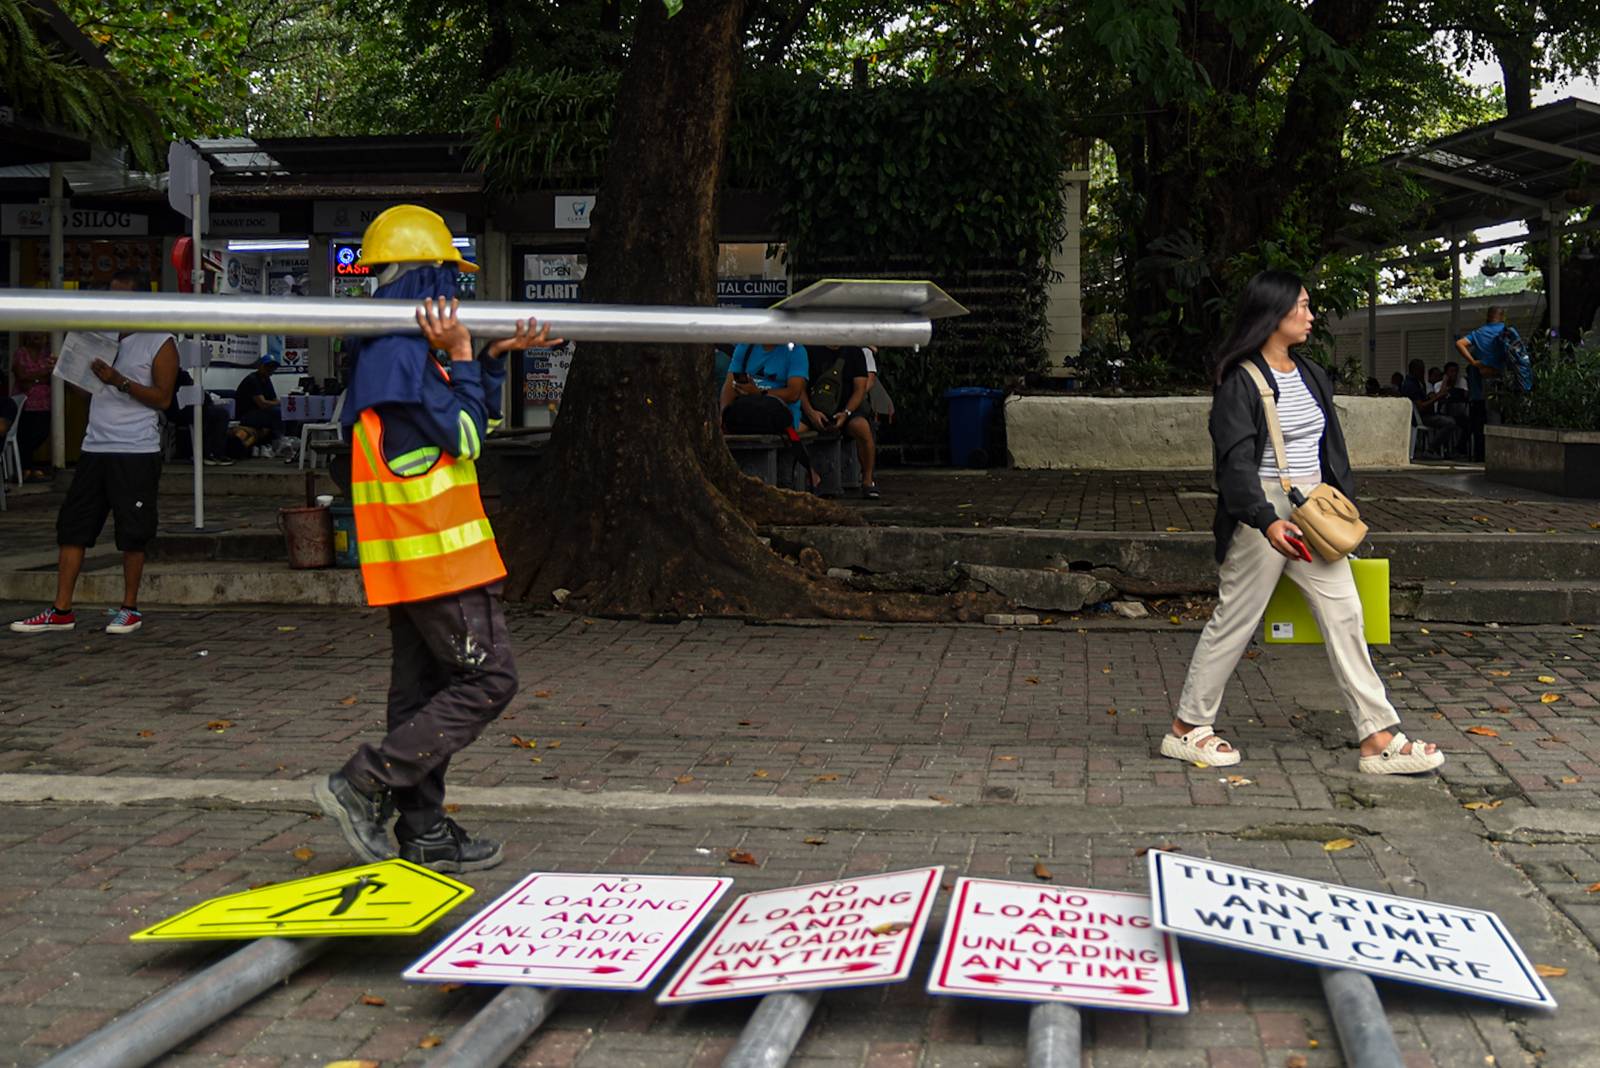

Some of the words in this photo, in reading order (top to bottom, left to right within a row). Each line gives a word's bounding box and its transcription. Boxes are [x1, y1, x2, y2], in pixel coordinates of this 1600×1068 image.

[72, 212, 131, 227] SILOG
[246, 218, 266, 226] DOC
[543, 266, 571, 276] OPEN
[525, 283, 579, 299] CLARIT
[744, 282, 786, 294] CLINIC
[592, 882, 643, 894] NO
[808, 885, 859, 901] NO
[517, 895, 690, 911] LOADING
[1038, 892, 1089, 907] NO
[1174, 862, 1311, 902] TURN
[1328, 892, 1478, 934] RIGHT
[737, 891, 913, 925] LOADING
[973, 902, 1153, 929] LOADING
[541, 912, 635, 925] AND
[770, 913, 865, 935] AND
[1223, 894, 1462, 953] ANYTIME
[475, 925, 664, 944] UNLOADING
[1015, 923, 1110, 941] AND
[457, 942, 649, 962] ANYTIME
[962, 935, 1160, 964] UNLOADING
[1194, 908, 1331, 951] WITH
[1351, 940, 1504, 985] CARE
[700, 940, 898, 974] ANYTIME
[961, 954, 1160, 983] ANYTIME
